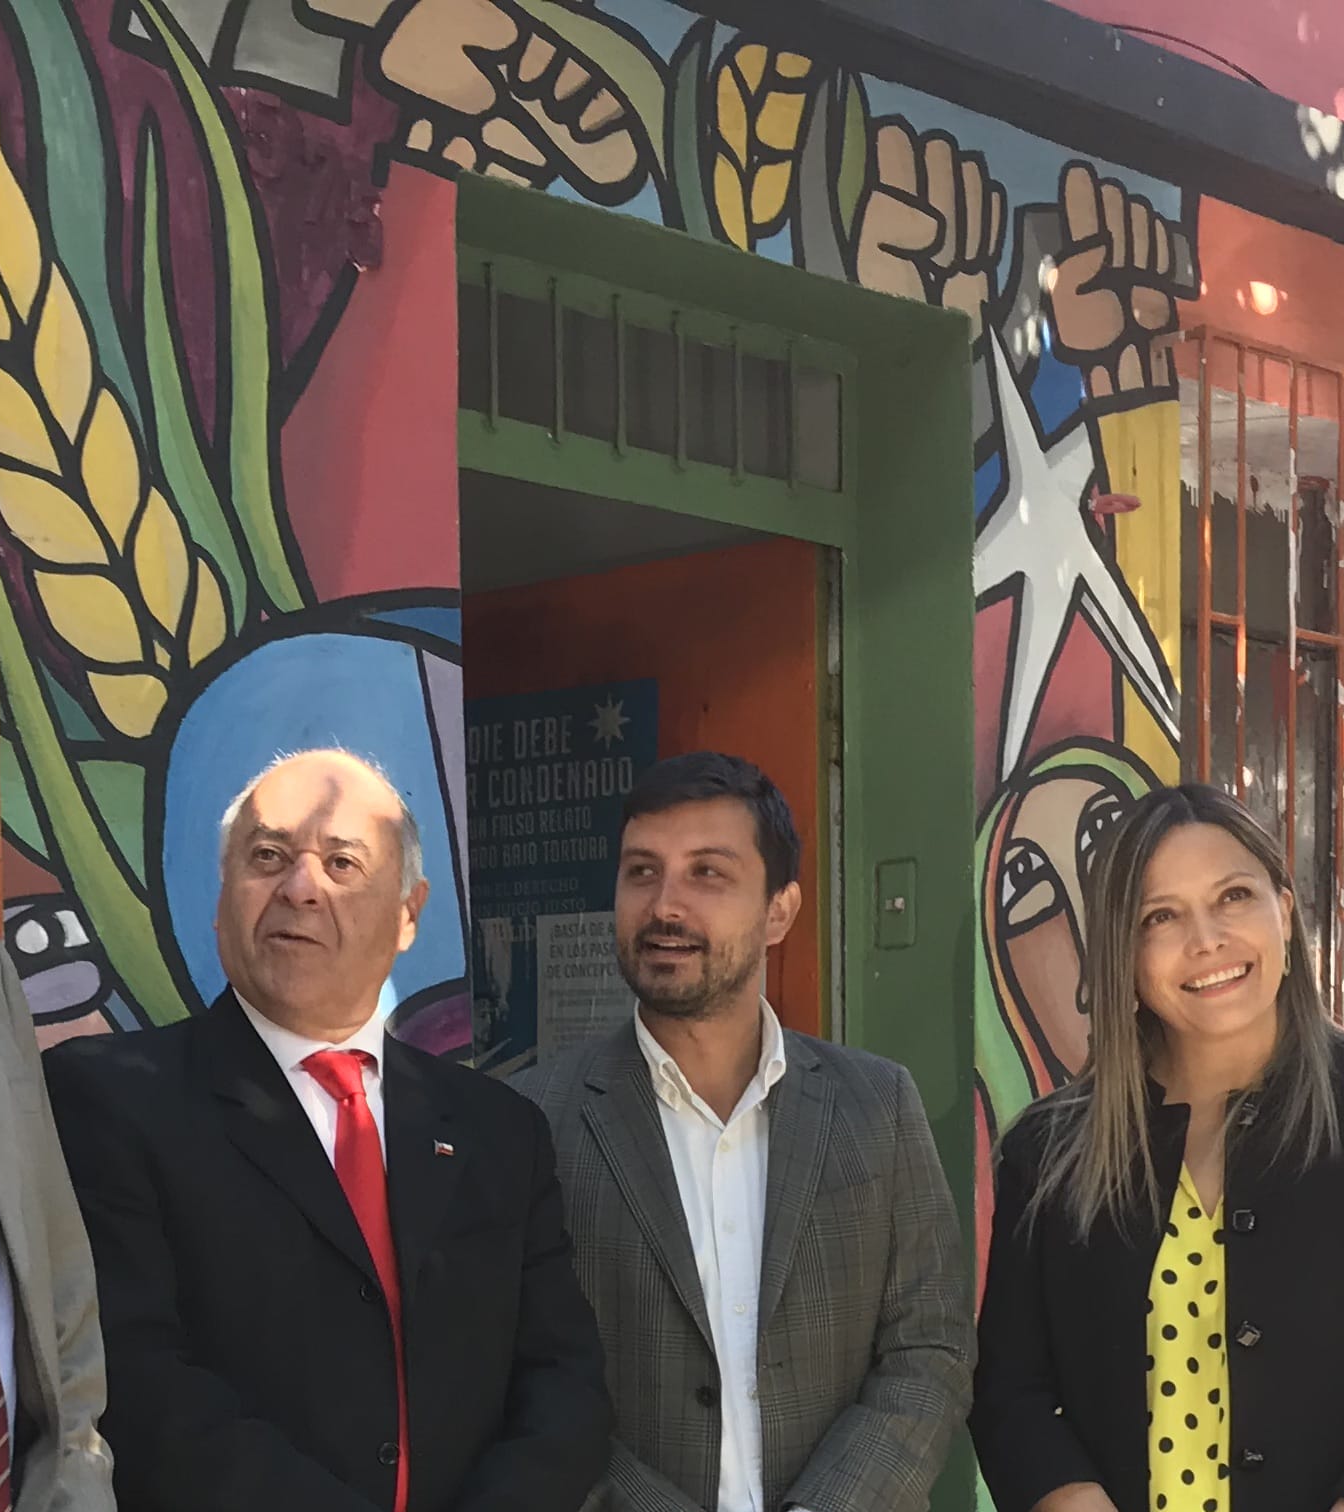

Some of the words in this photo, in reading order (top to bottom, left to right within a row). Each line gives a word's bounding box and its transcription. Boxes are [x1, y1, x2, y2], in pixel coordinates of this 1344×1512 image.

[513, 714, 573, 761] DEBE
[488, 756, 633, 809] CONDENADO
[492, 810, 535, 838] FALSO
[539, 804, 592, 834] RELATO
[503, 841, 538, 868] BAJO
[542, 834, 609, 865] TORTURA
[513, 878, 579, 897] DERECHO
[545, 896, 586, 913] JUSTO
[550, 941, 564, 959] EN
[567, 941, 587, 959] LOS
